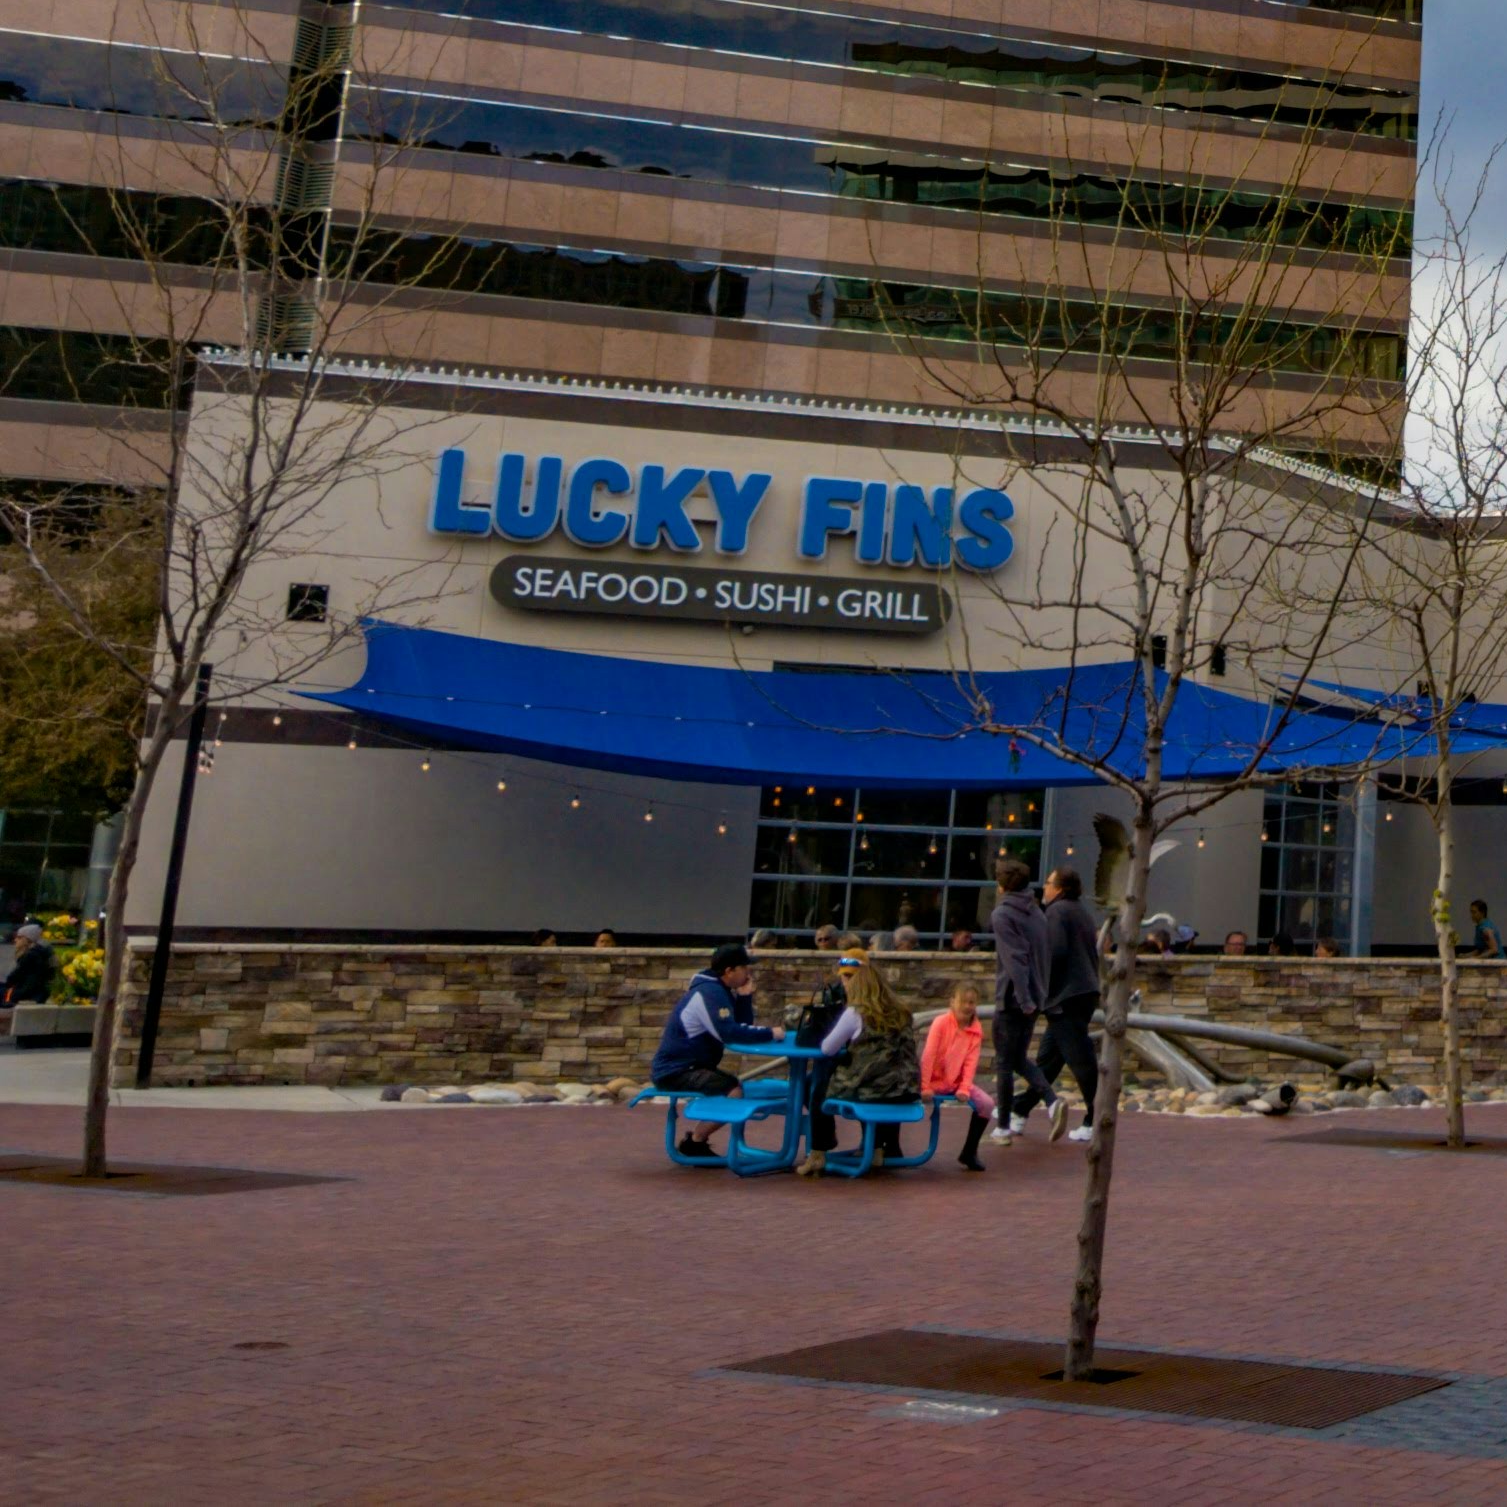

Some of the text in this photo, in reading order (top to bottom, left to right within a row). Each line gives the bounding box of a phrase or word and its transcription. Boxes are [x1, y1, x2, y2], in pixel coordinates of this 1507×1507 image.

[428, 448, 1016, 572] LUCKY FINS
[513, 567, 930, 622] SEAFOOD SUSHI GRILL
